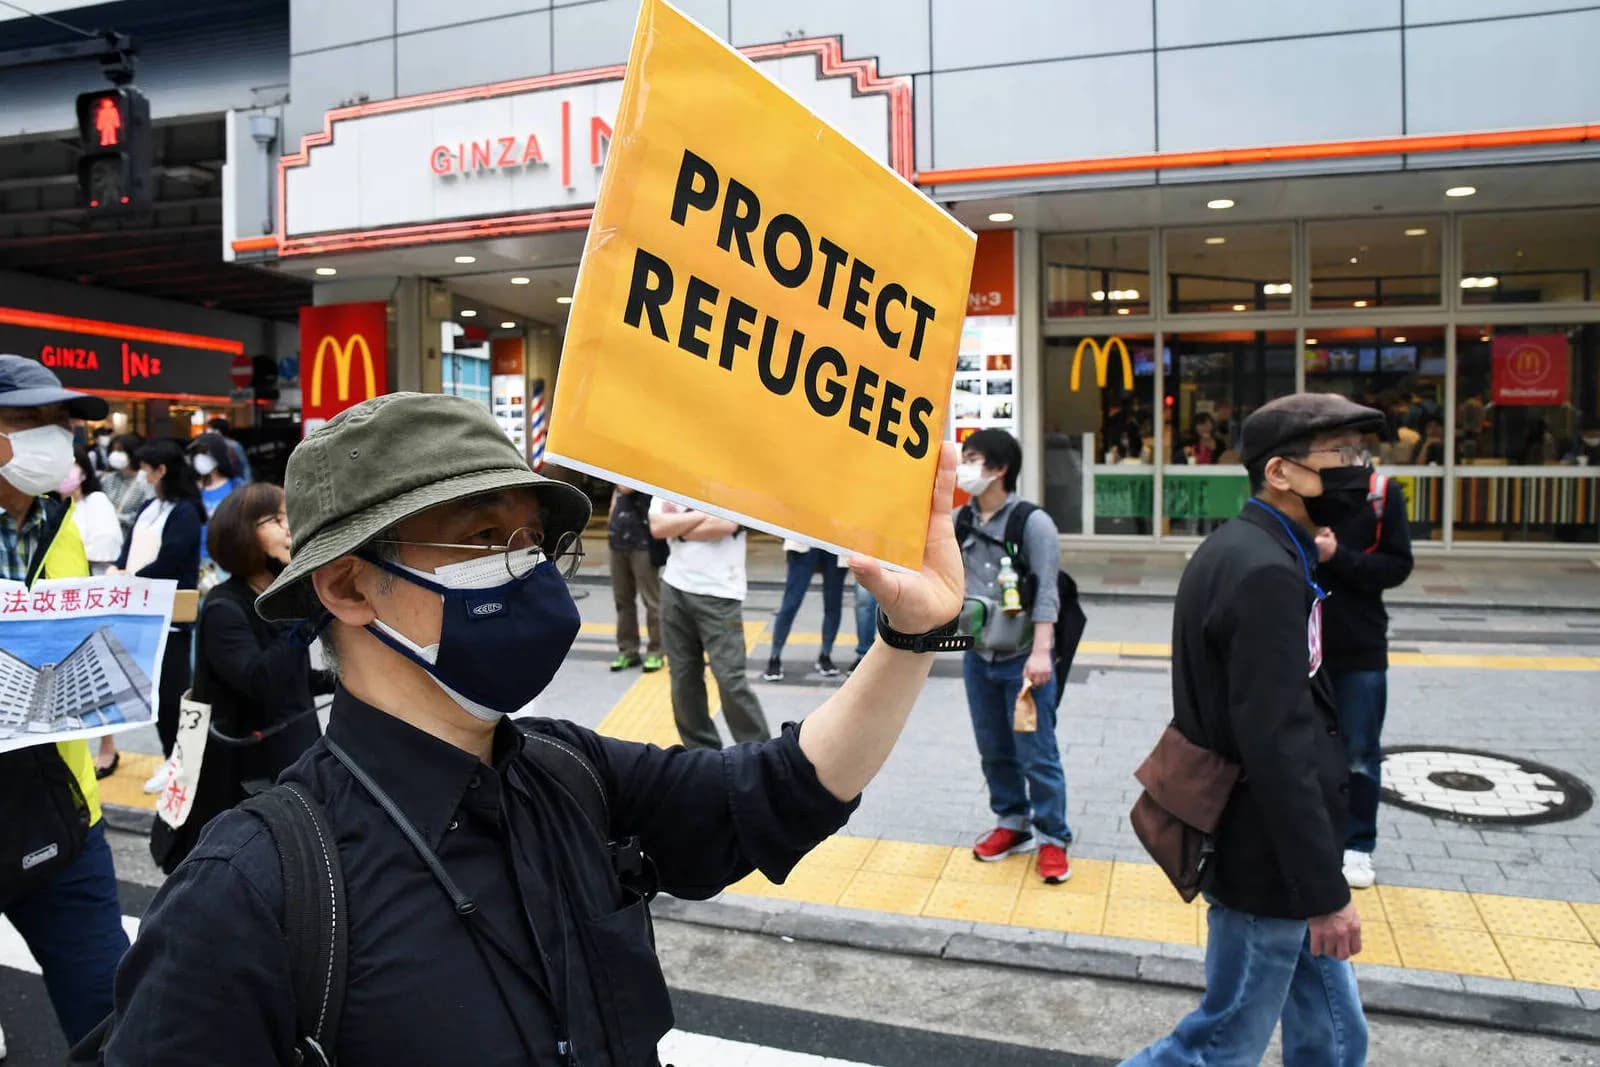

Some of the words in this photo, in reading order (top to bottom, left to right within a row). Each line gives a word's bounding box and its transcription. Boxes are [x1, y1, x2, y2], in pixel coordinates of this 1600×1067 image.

[430, 133, 544, 175] GINZA
[670, 148, 936, 362] PROTECT
[41, 344, 99, 370] GINZA
[624, 247, 934, 460] REFUGEES
